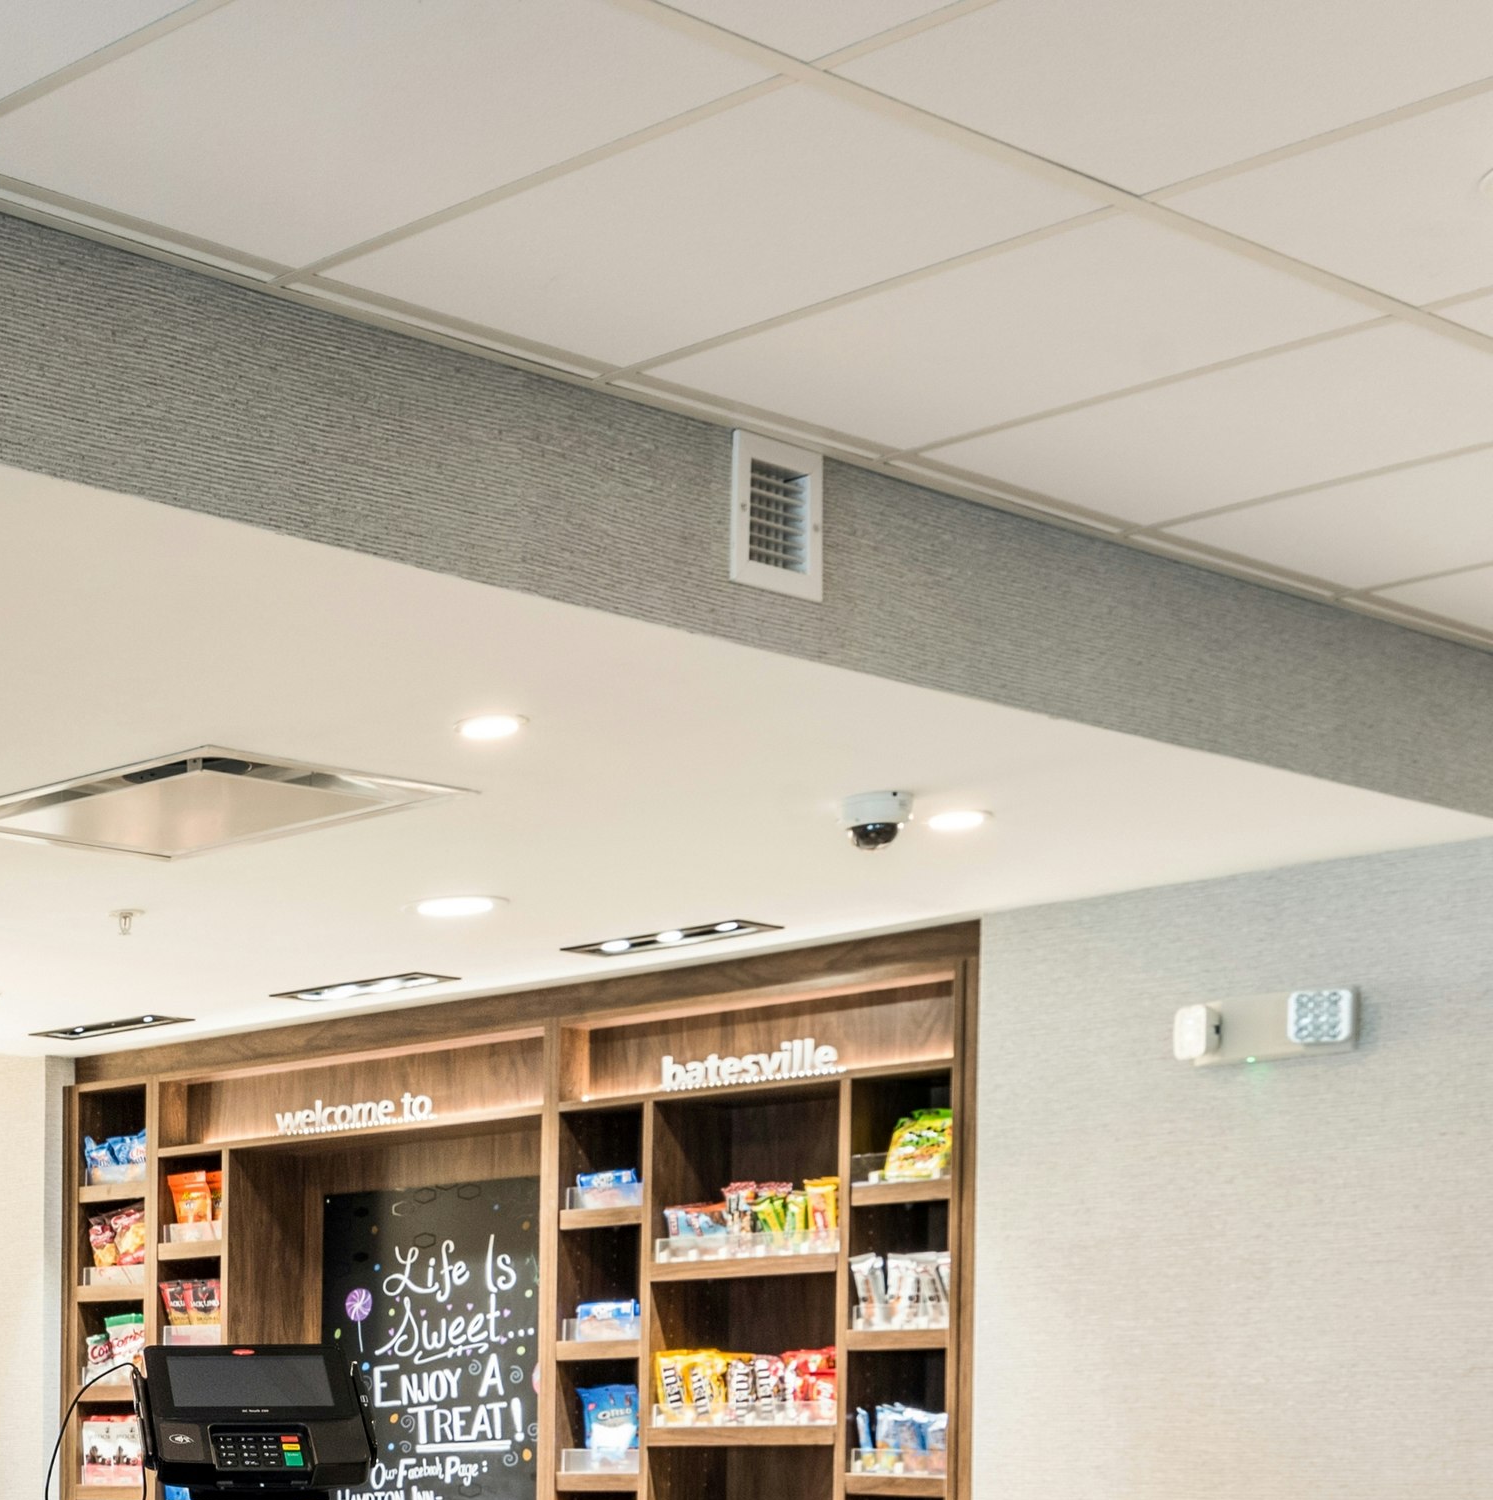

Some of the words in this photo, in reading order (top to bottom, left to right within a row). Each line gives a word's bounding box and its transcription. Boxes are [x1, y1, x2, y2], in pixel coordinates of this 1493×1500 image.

[661, 1038, 839, 1091] batesville
[275, 1099, 396, 1134] welcome
[401, 1092, 433, 1121] to
[382, 1239, 470, 1302] Life
[485, 1233, 517, 1293] Is
[373, 1363, 462, 1408] ENJOY
[478, 1353, 505, 1398] A
[597, 1406, 633, 1421] OREO
[370, 1461, 398, 1490] Our
[395, 1455, 444, 1488] Facebook
